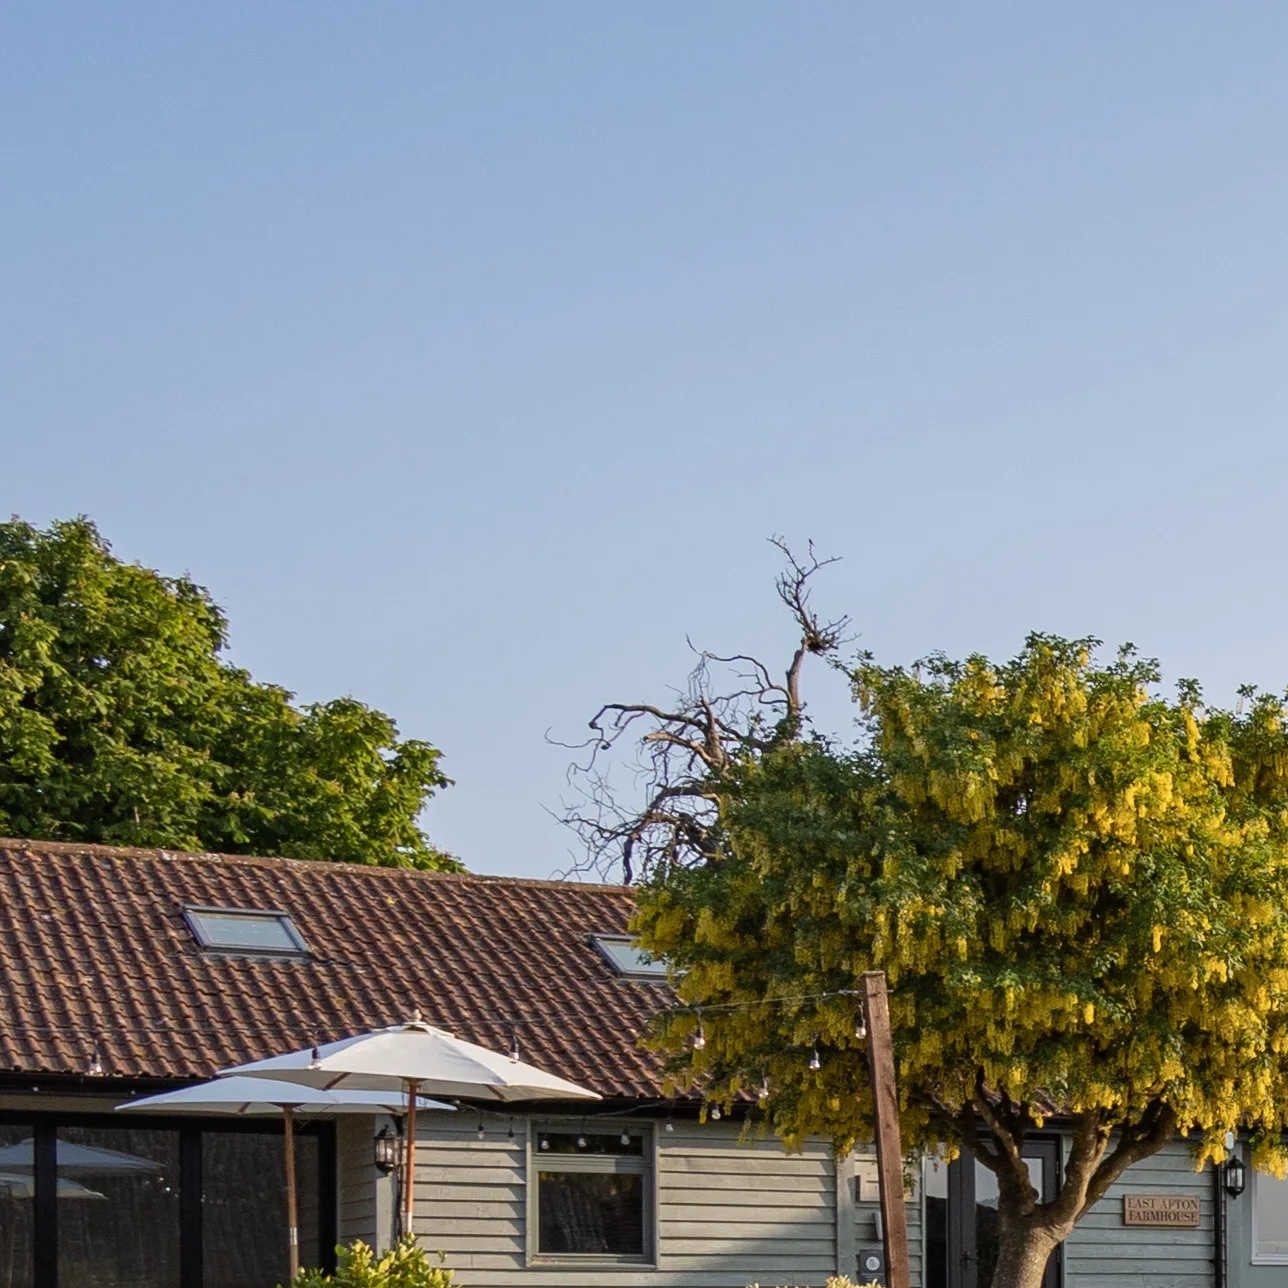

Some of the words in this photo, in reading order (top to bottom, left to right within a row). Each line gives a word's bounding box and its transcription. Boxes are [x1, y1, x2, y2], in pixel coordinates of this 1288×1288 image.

[1128, 1198, 1156, 1209] EAST
[1161, 1198, 1198, 1209] AFTON
[1129, 1210, 1198, 1223] FARMHOUSE
